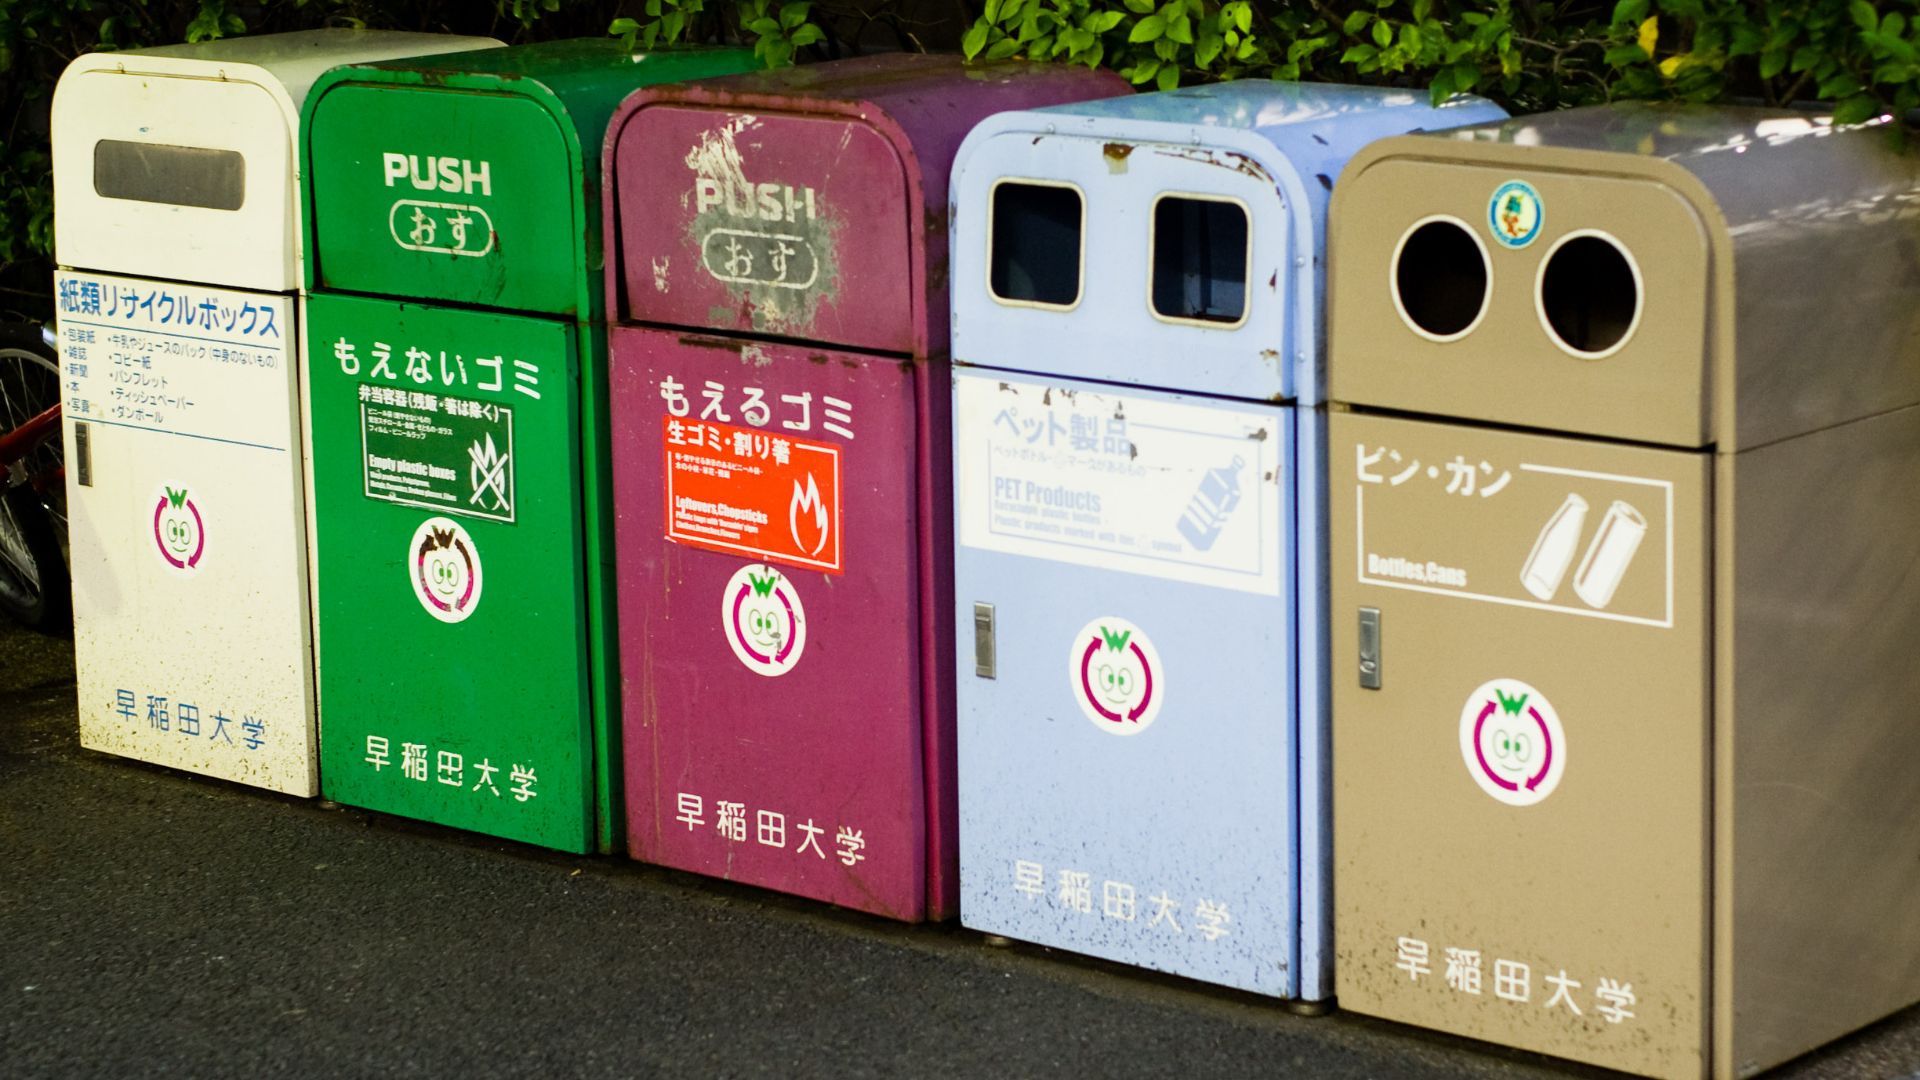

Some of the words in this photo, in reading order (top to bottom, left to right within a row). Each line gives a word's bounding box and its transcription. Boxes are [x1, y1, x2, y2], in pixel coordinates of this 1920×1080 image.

[383, 152, 491, 196] PUSH
[696, 178, 816, 223] PUSH
[409, 206, 474, 250] おす
[724, 237, 796, 282] おす
[59, 278, 279, 338] 紙類リサイクルボックス
[334, 337, 541, 400] もえないゴミ
[660, 375, 854, 440] もえるゴミ
[993, 406, 1135, 456] ペット製品
[368, 454, 396, 472] Empty
[396, 459, 428, 476] plastic
[667, 420, 791, 466] 生ゴミ・割り箸
[994, 476, 1022, 501] PET
[1026, 480, 1102, 513] Products
[1356, 443, 1512, 498] ビン・カン
[1368, 553, 1467, 588] Bottles,Cans
[116, 689, 265, 750] 早稲田大学
[365, 735, 538, 802] 早稲田大学
[676, 793, 865, 866] 早稲田大学
[1014, 859, 1230, 941] 早稲田大学
[1396, 936, 1636, 1024] 早稲田大学
